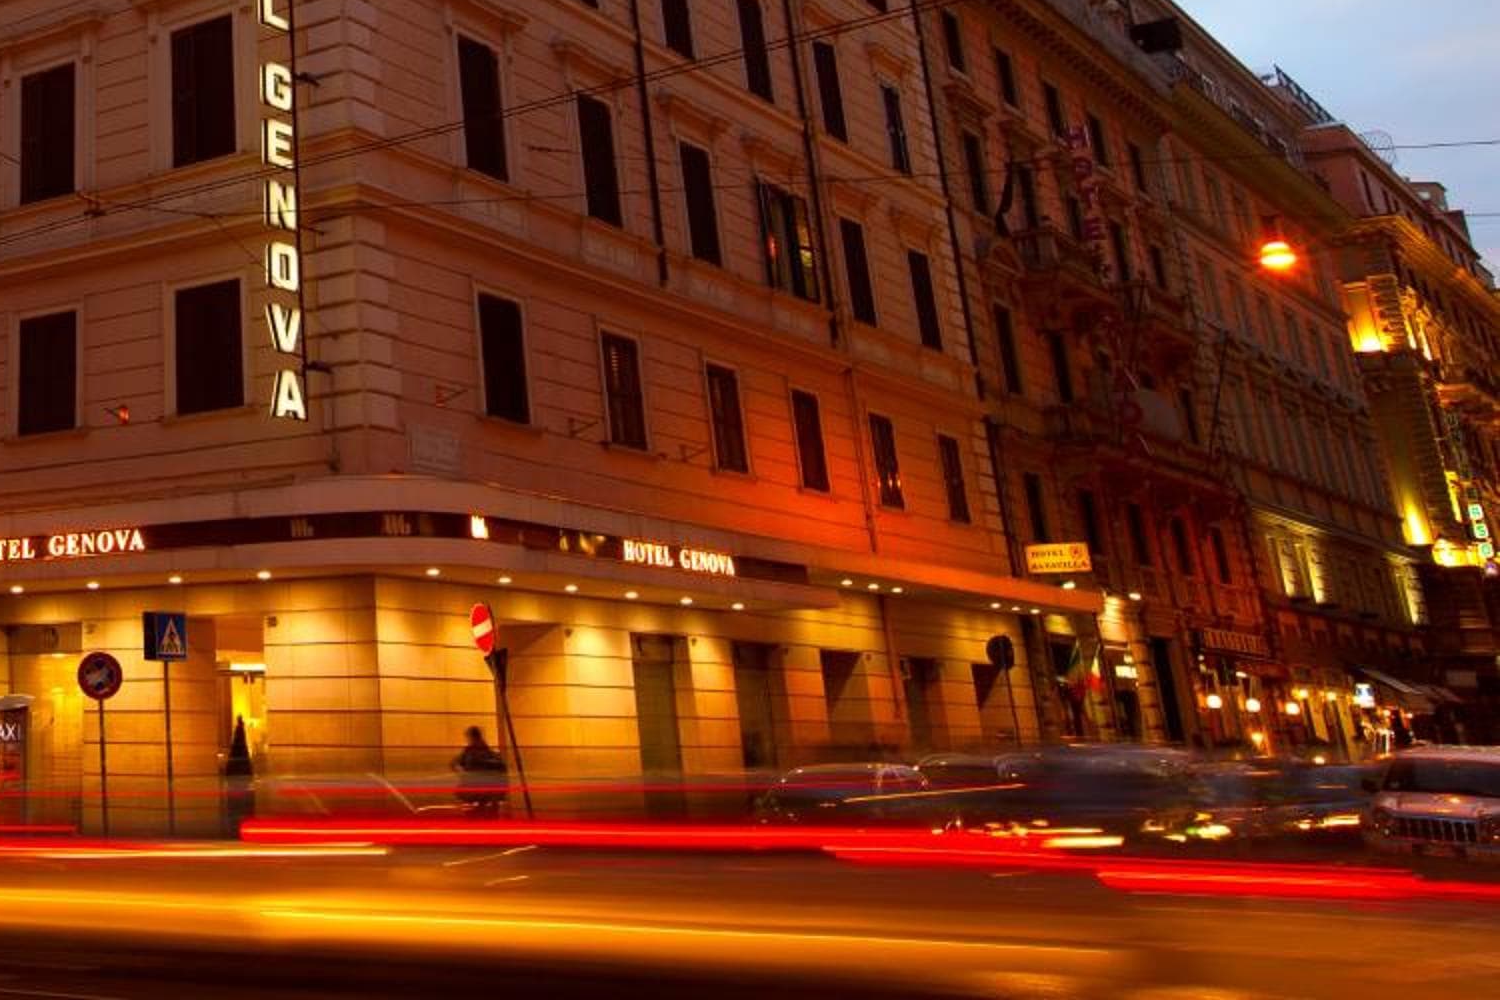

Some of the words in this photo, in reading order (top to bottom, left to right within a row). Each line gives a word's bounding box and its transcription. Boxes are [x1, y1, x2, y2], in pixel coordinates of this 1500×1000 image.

[261, 62, 306, 421] GENOVA
[49, 528, 145, 556] GENOVA
[623, 540, 674, 567] HOTEL
[679, 549, 735, 576] GENOVA
